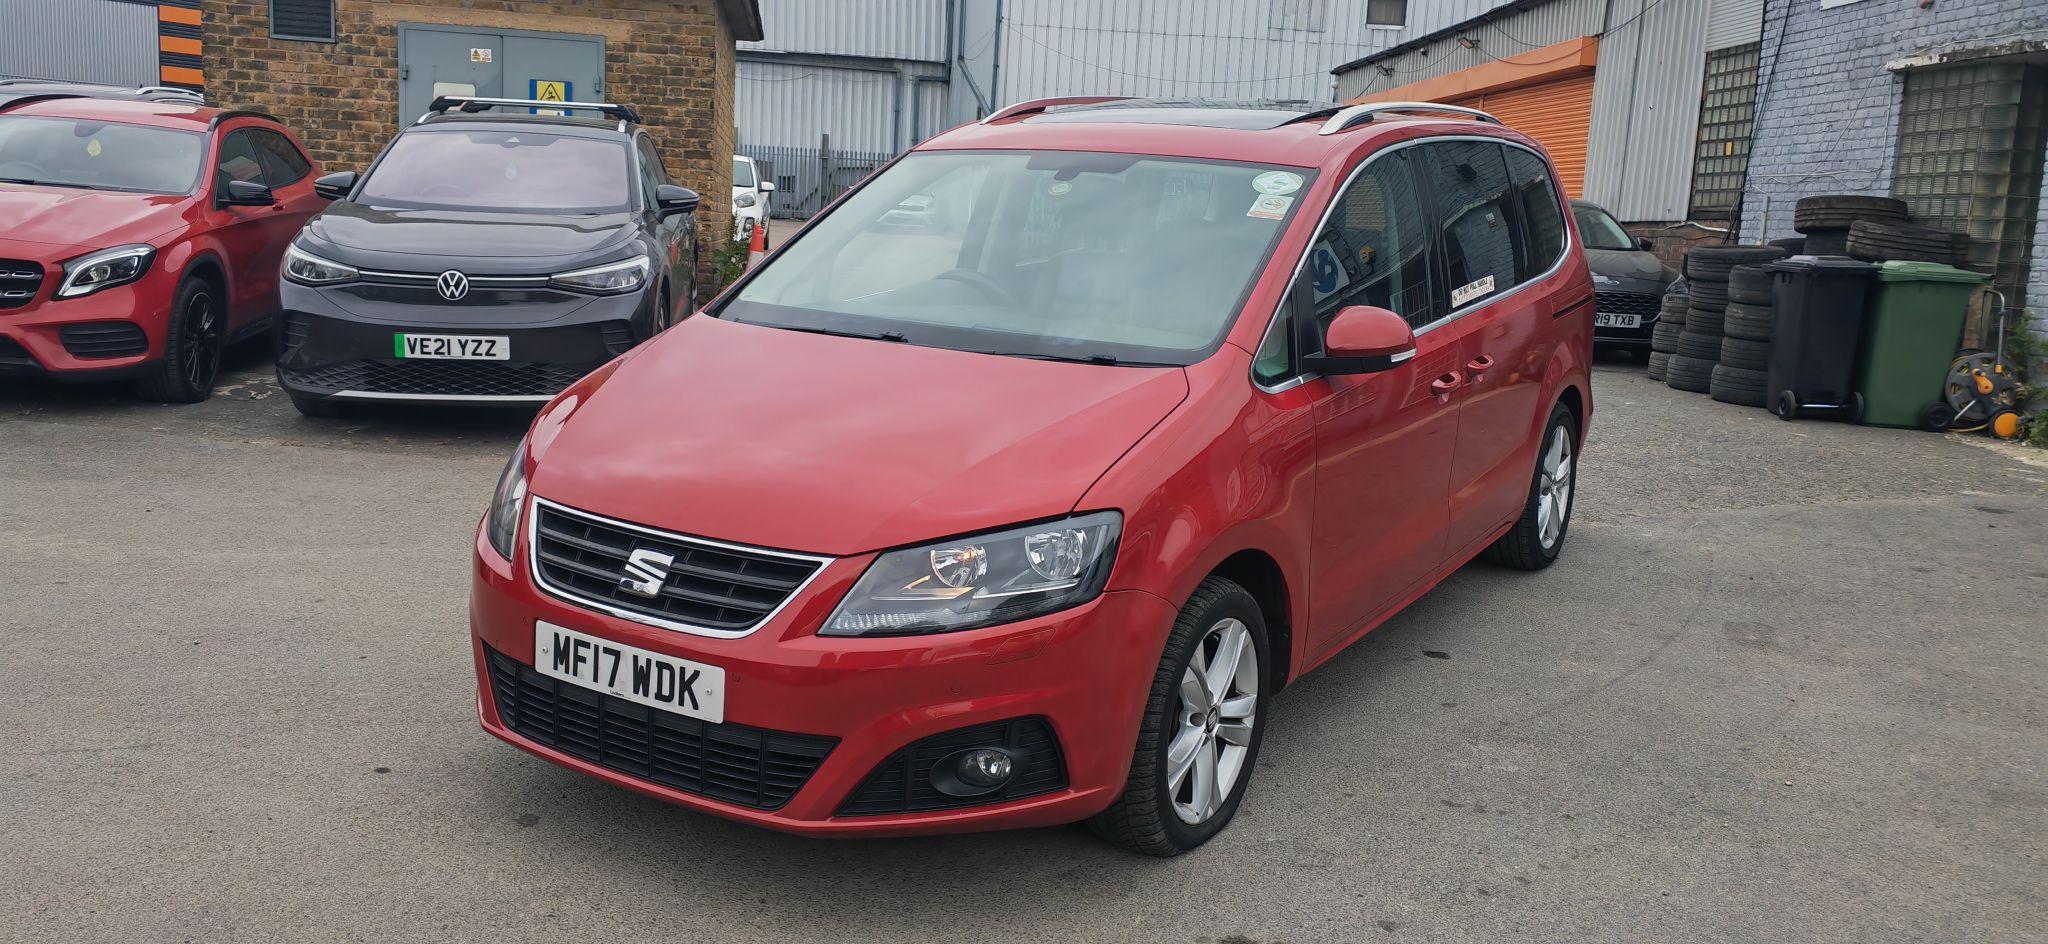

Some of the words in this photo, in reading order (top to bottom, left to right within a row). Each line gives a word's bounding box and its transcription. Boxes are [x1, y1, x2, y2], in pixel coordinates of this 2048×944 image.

[1595, 313, 1610, 325] R19
[1614, 314, 1634, 326] TXB
[406, 337, 451, 356] VE21
[457, 338, 497, 357] YZZ
[553, 632, 621, 688] MF17
[632, 654, 701, 710] WDK
